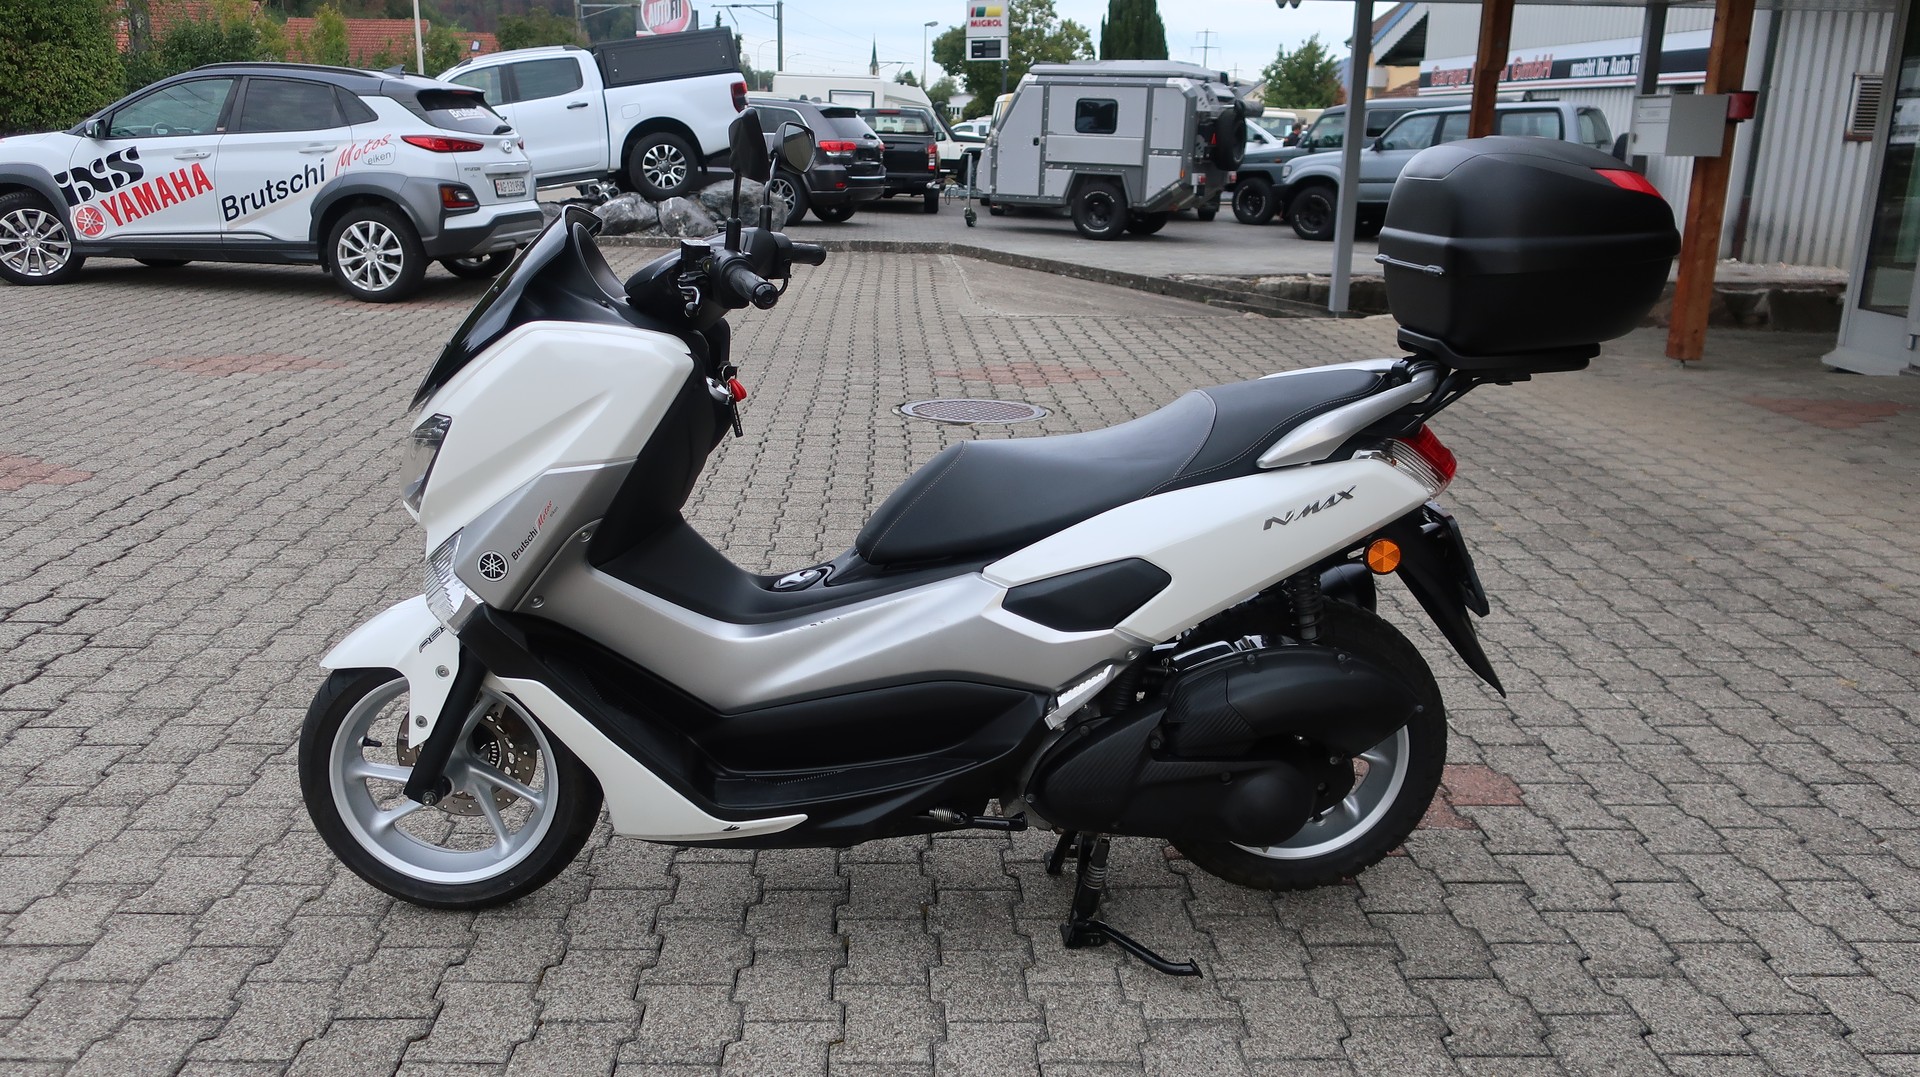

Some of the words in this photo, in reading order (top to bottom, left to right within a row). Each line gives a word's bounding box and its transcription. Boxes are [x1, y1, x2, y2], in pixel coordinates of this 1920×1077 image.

[970, 19, 1002, 27] MIGROL
[1431, 65, 1469, 88] Garage
[1511, 54, 1553, 80] GmbH
[1570, 59, 1597, 77] macht
[1608, 56, 1631, 75] Auto
[1631, 55, 1640, 74] fi
[367, 152, 392, 165] eiken
[221, 157, 326, 222] Brutschi
[335, 133, 392, 176] Motos
[100, 163, 214, 227] YAMAHA
[511, 526, 540, 561] Brutschi
[536, 500, 553, 532] Motos
